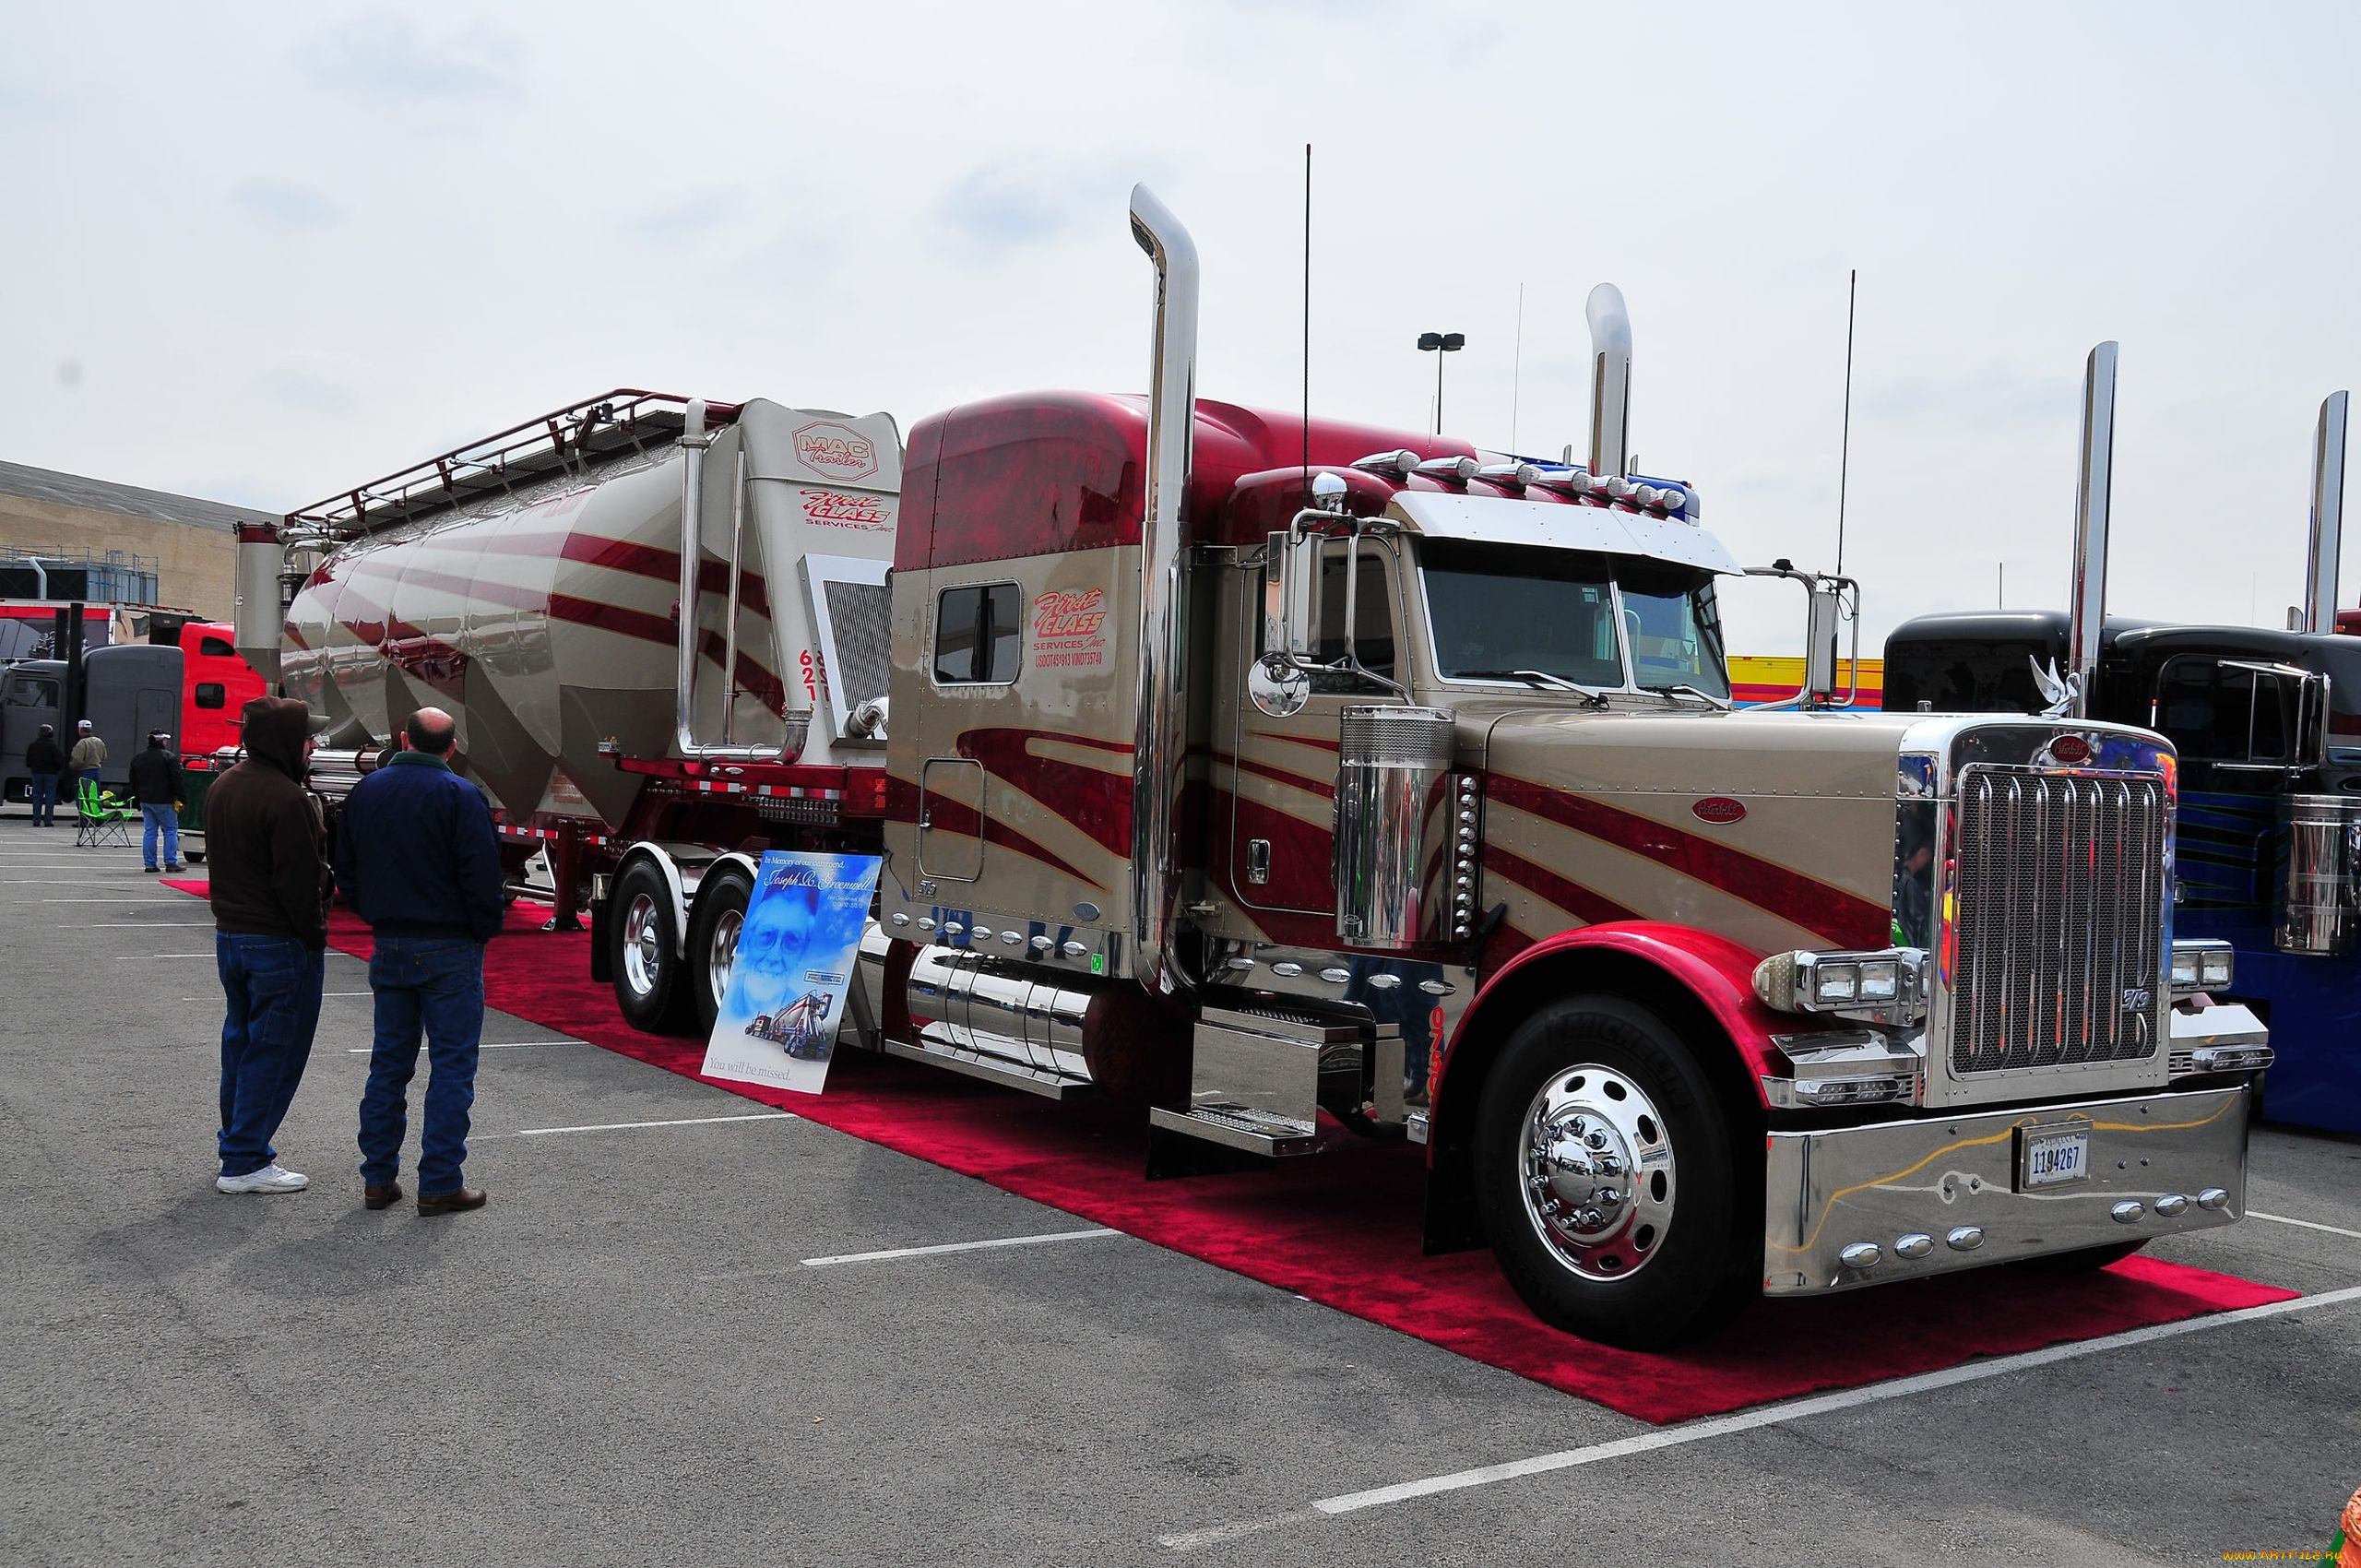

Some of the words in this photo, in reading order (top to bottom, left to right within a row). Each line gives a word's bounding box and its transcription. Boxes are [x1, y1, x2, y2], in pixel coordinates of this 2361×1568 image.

[800, 435, 869, 458] MAC
[805, 446, 866, 468] Trailer
[800, 489, 884, 510] First
[805, 518, 868, 530] SERVICES
[809, 505, 892, 523] CLASS
[1034, 588, 1103, 628] First
[1038, 611, 1107, 638] CLASS
[1033, 639, 1083, 651] SERVICES
[800, 649, 816, 701] 621
[763, 868, 799, 890] Joseph
[709, 1056, 726, 1070] You
[728, 1061, 744, 1074] will
[746, 1063, 756, 1075] be
[757, 1066, 791, 1081] missed.
[2033, 1146, 2080, 1174] 1194267
